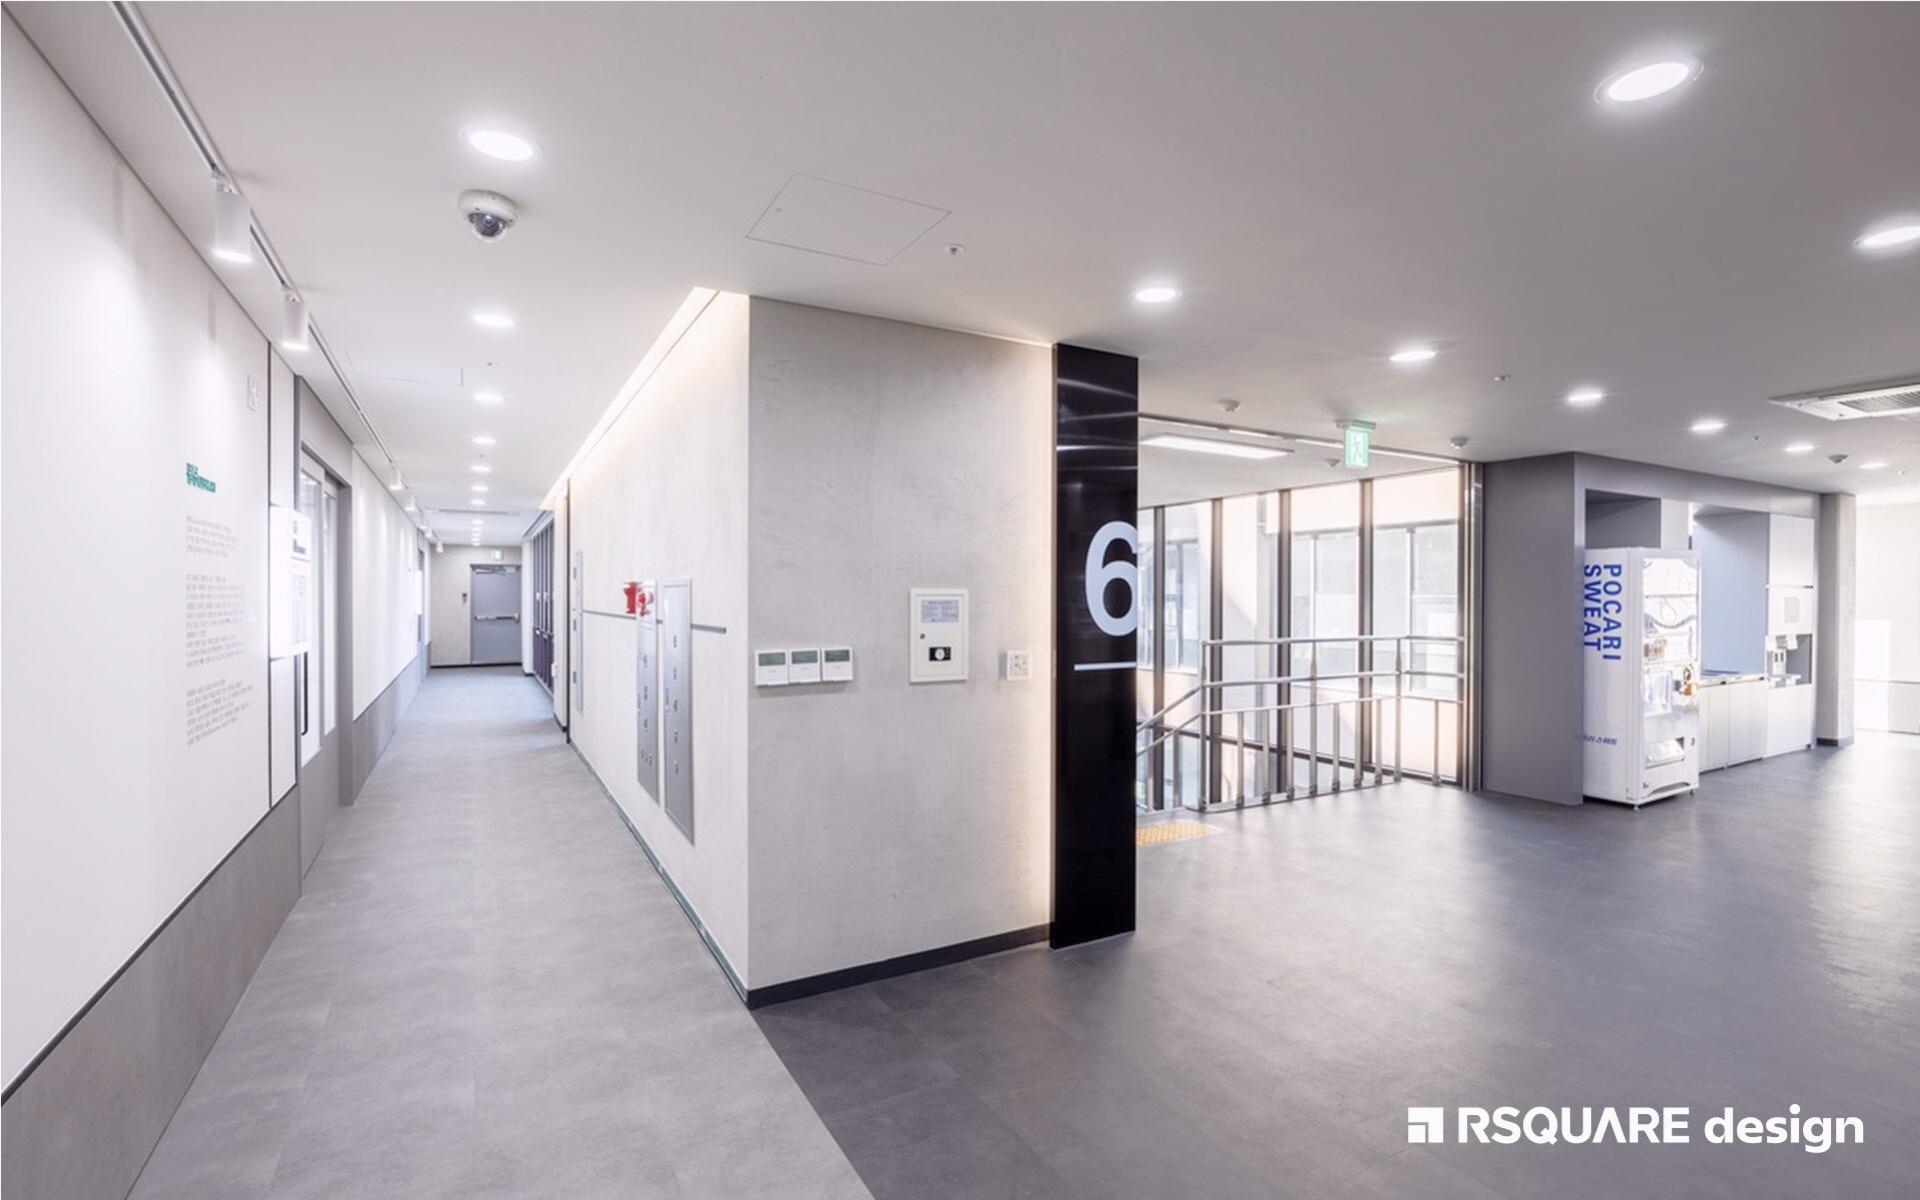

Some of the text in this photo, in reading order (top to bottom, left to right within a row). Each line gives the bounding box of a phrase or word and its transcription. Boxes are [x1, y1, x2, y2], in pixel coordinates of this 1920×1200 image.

[1086, 521, 1138, 636] 6
[1584, 565, 1601, 651] SWEAT
[1603, 564, 1622, 660] POCARI
